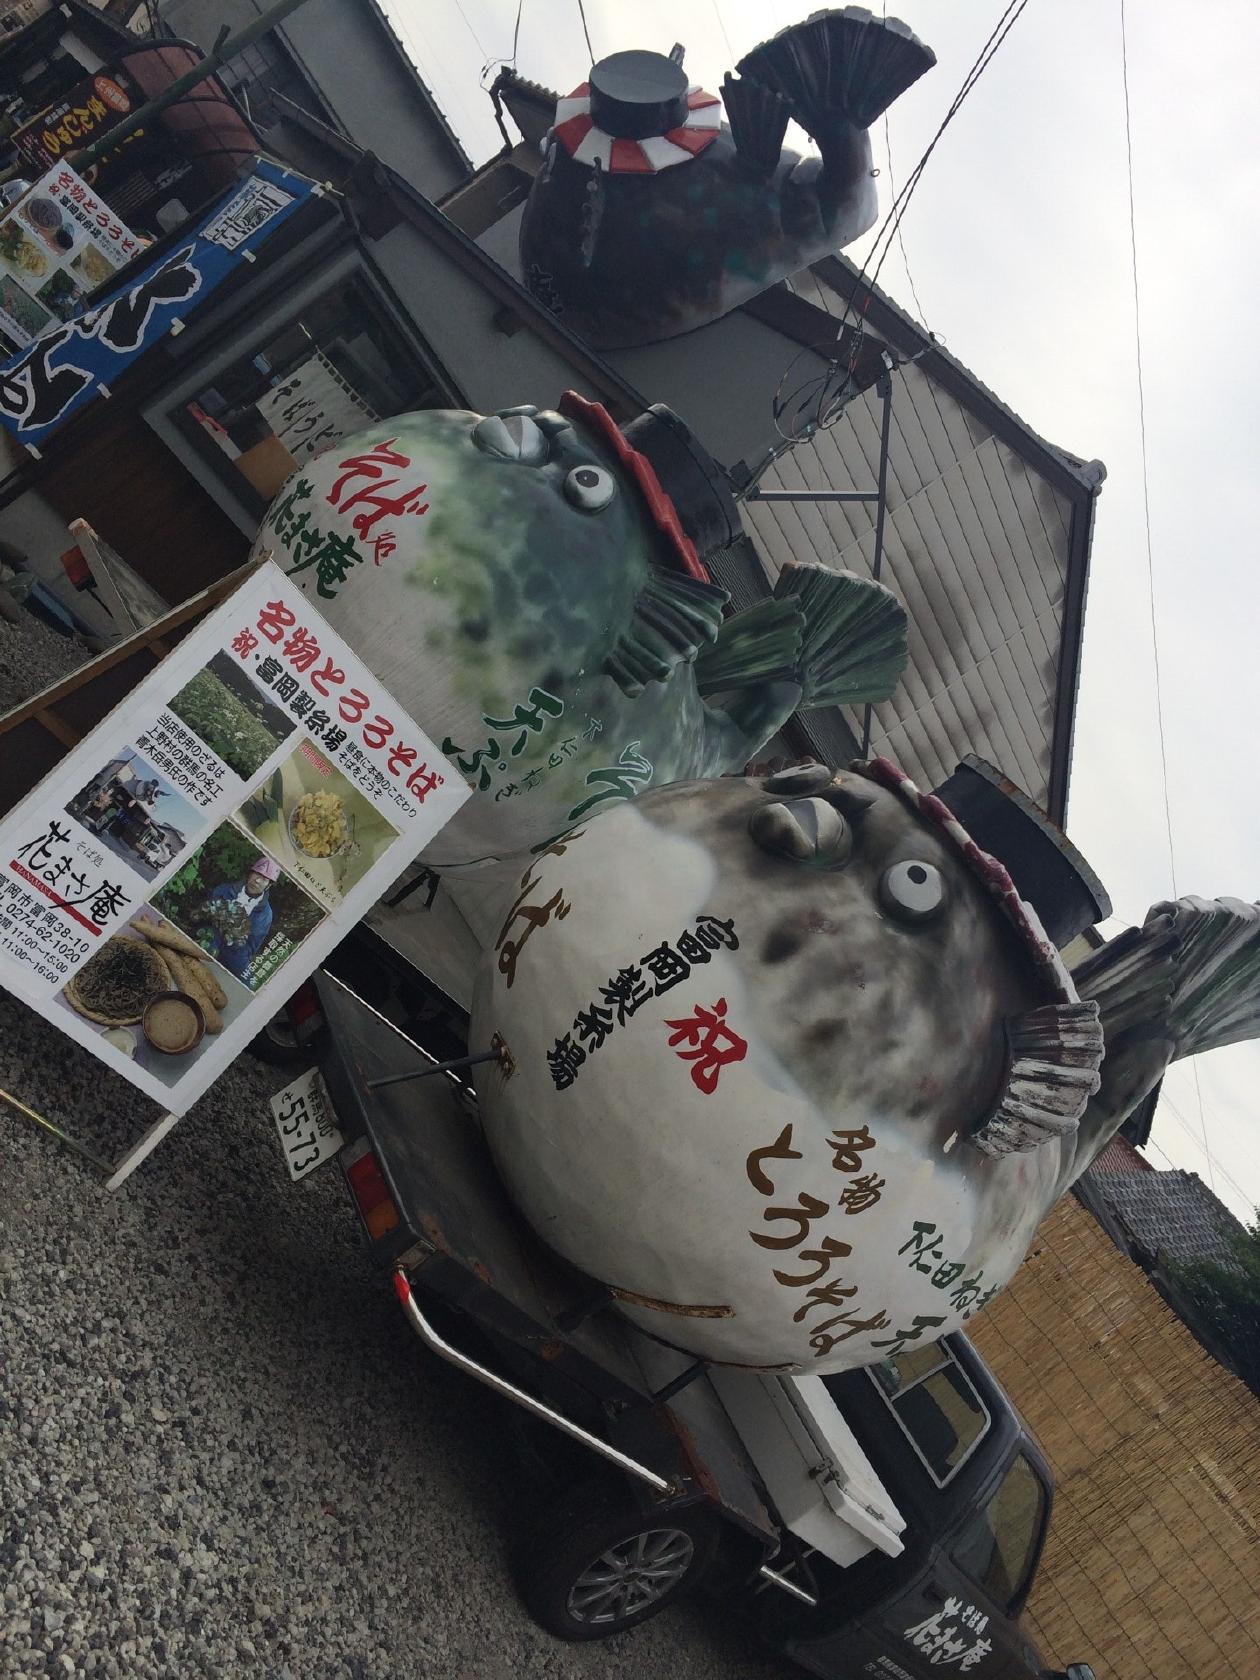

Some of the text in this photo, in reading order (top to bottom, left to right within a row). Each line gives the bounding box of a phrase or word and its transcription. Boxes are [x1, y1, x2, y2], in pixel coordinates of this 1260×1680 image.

[41, 95, 108, 154] まんじゅう
[58, 171, 140, 259] 名物とろろそ
[269, 478, 364, 600] 花まさ庵
[257, 600, 445, 805] 名物とろろそば
[135, 735, 213, 806] 青木岳男氏の作です
[145, 725, 224, 798] 上野村の群馬の名工
[156, 712, 226, 779] 当店使用のざるは
[338, 752, 384, 800] そばをどうぞ
[345, 741, 417, 818] 昼食に本物のこだわり
[18, 820, 131, 926] 花まさ庵
[76, 841, 104, 868] そば処
[6, 903, 81, 963] 0274-62-1020
[547, 916, 740, 1091] 富岡製糸場
[663, 997, 748, 1095] 祝
[279, 1096, 320, 1172] 55-73
[825, 1125, 886, 1215] 名物
[746, 1123, 892, 1357] とろろそば
[903, 1596, 993, 1672] 花まさ庵
